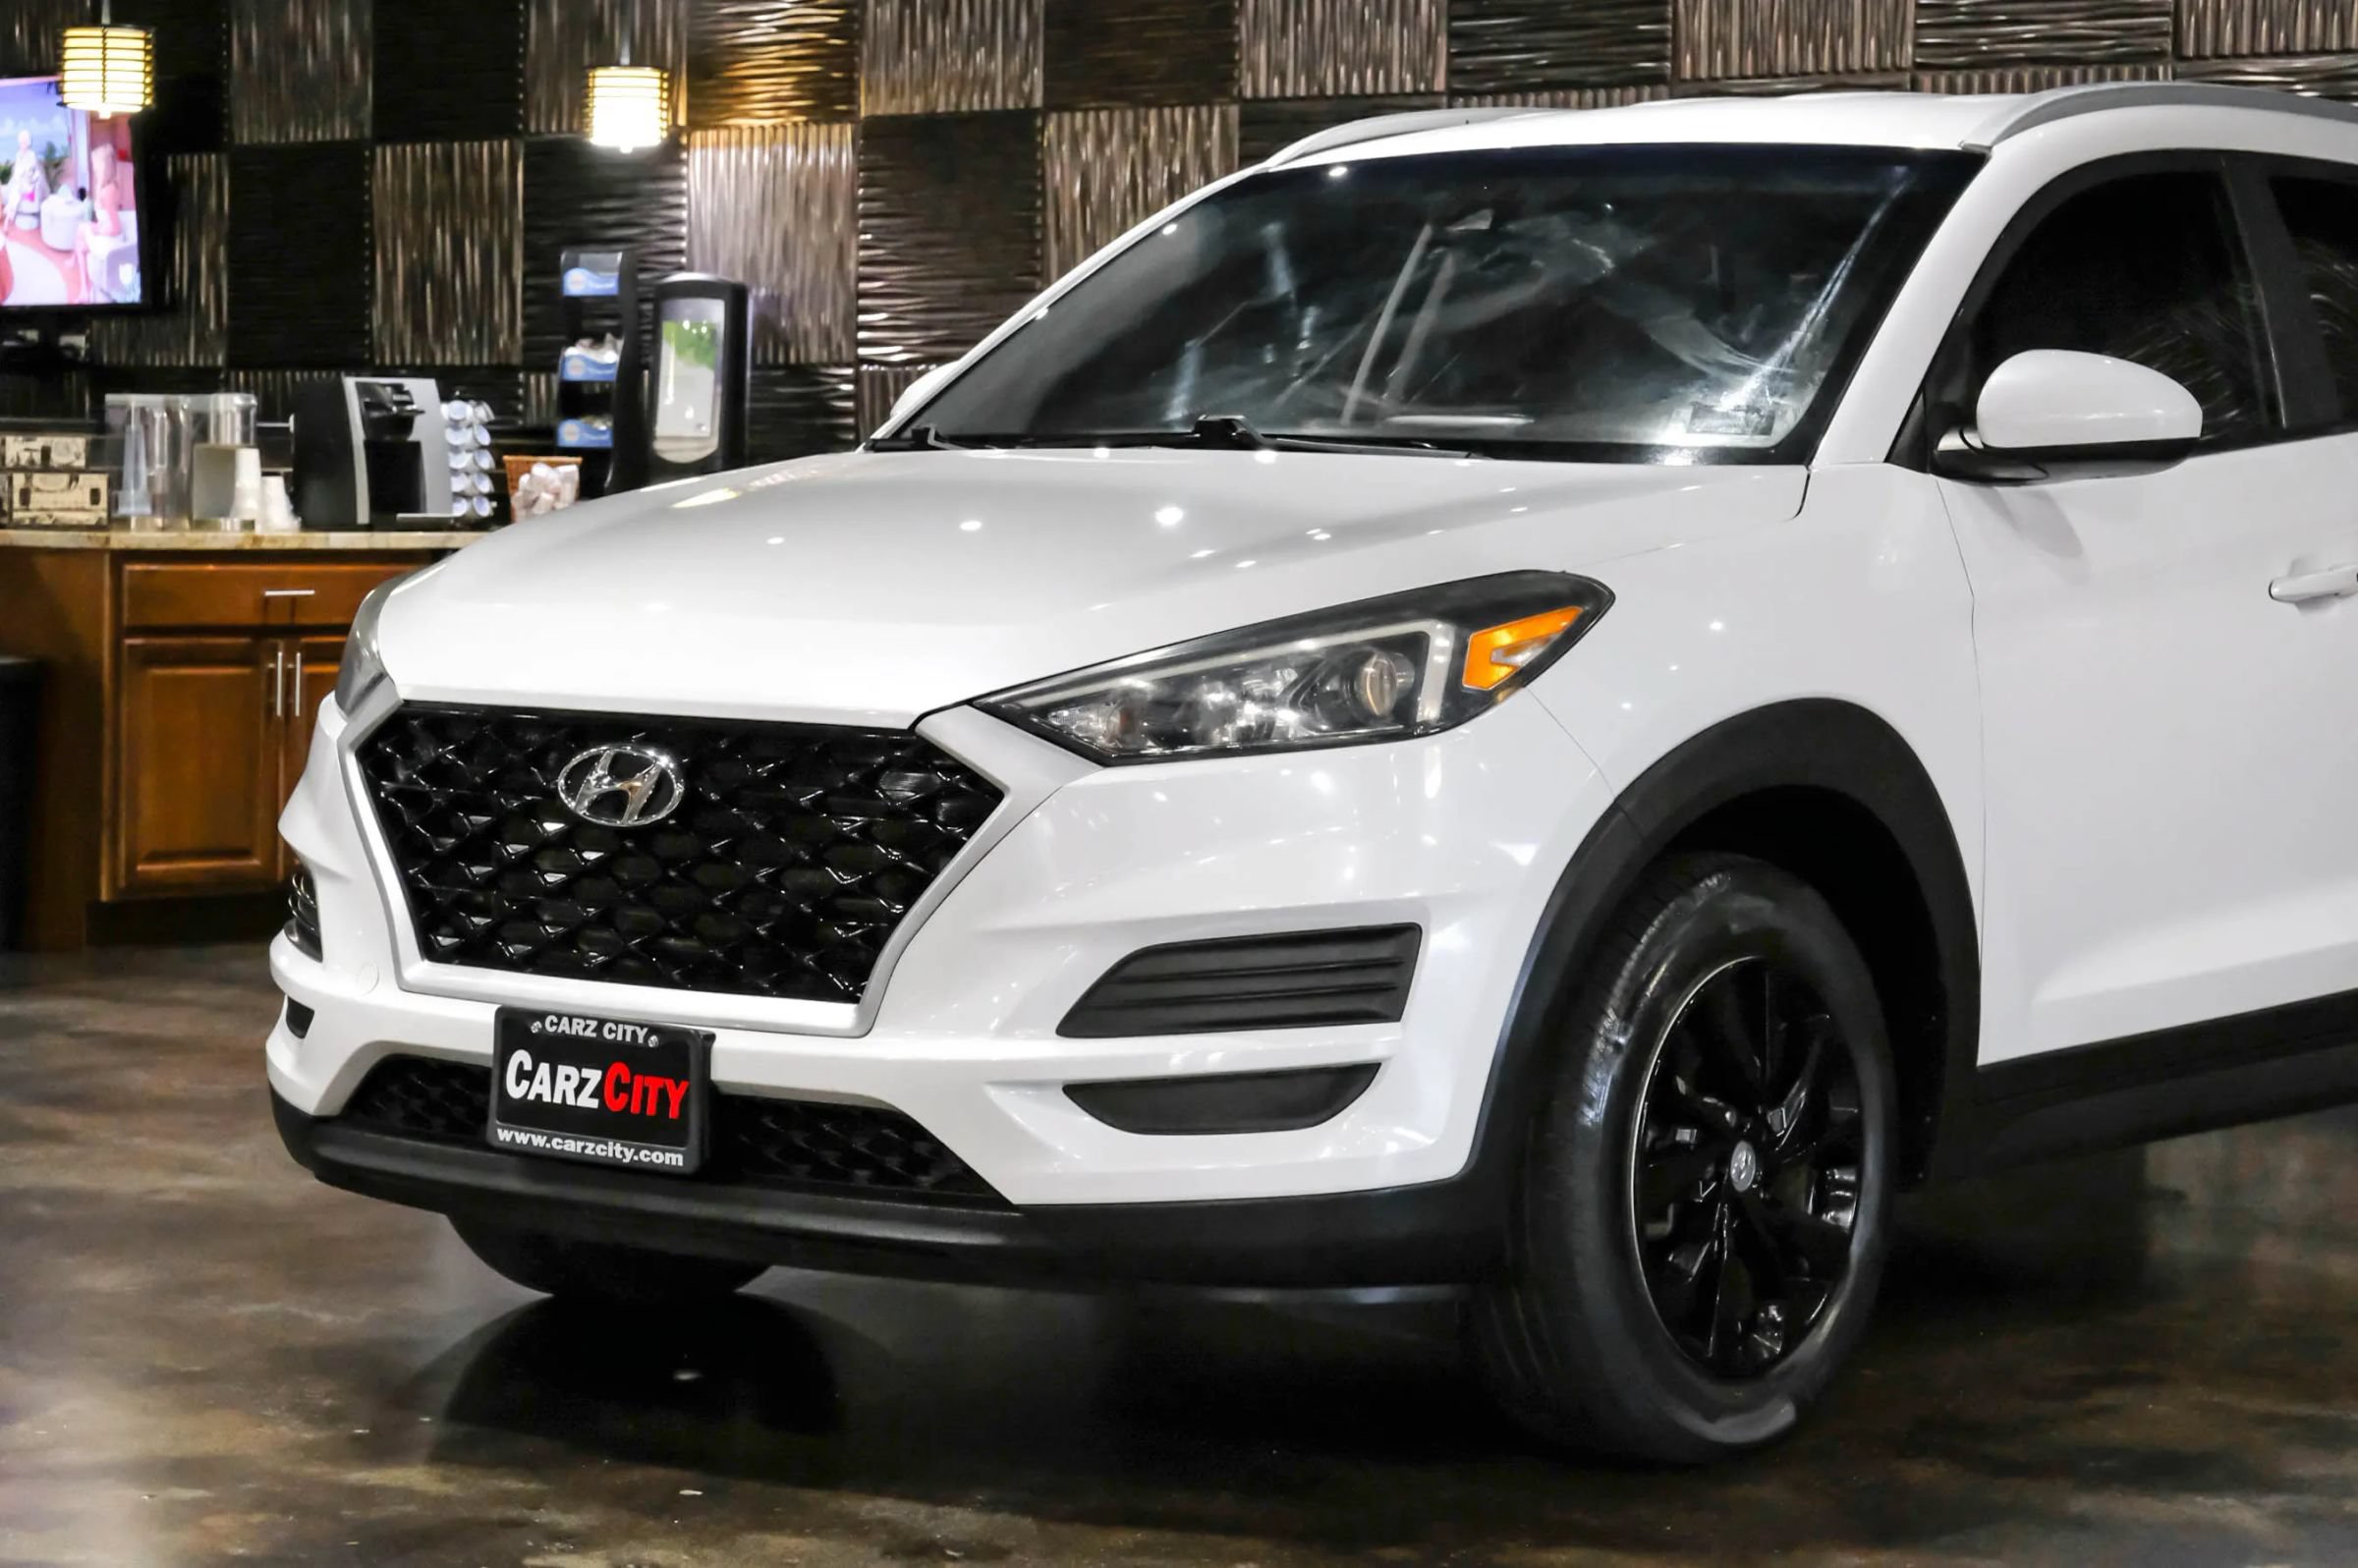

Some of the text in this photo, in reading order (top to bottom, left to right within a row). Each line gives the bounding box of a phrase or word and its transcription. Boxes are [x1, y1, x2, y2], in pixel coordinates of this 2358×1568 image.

[544, 1015, 648, 1044] CARZ CITY
[496, 1128, 684, 1167] www.carzcity.com
